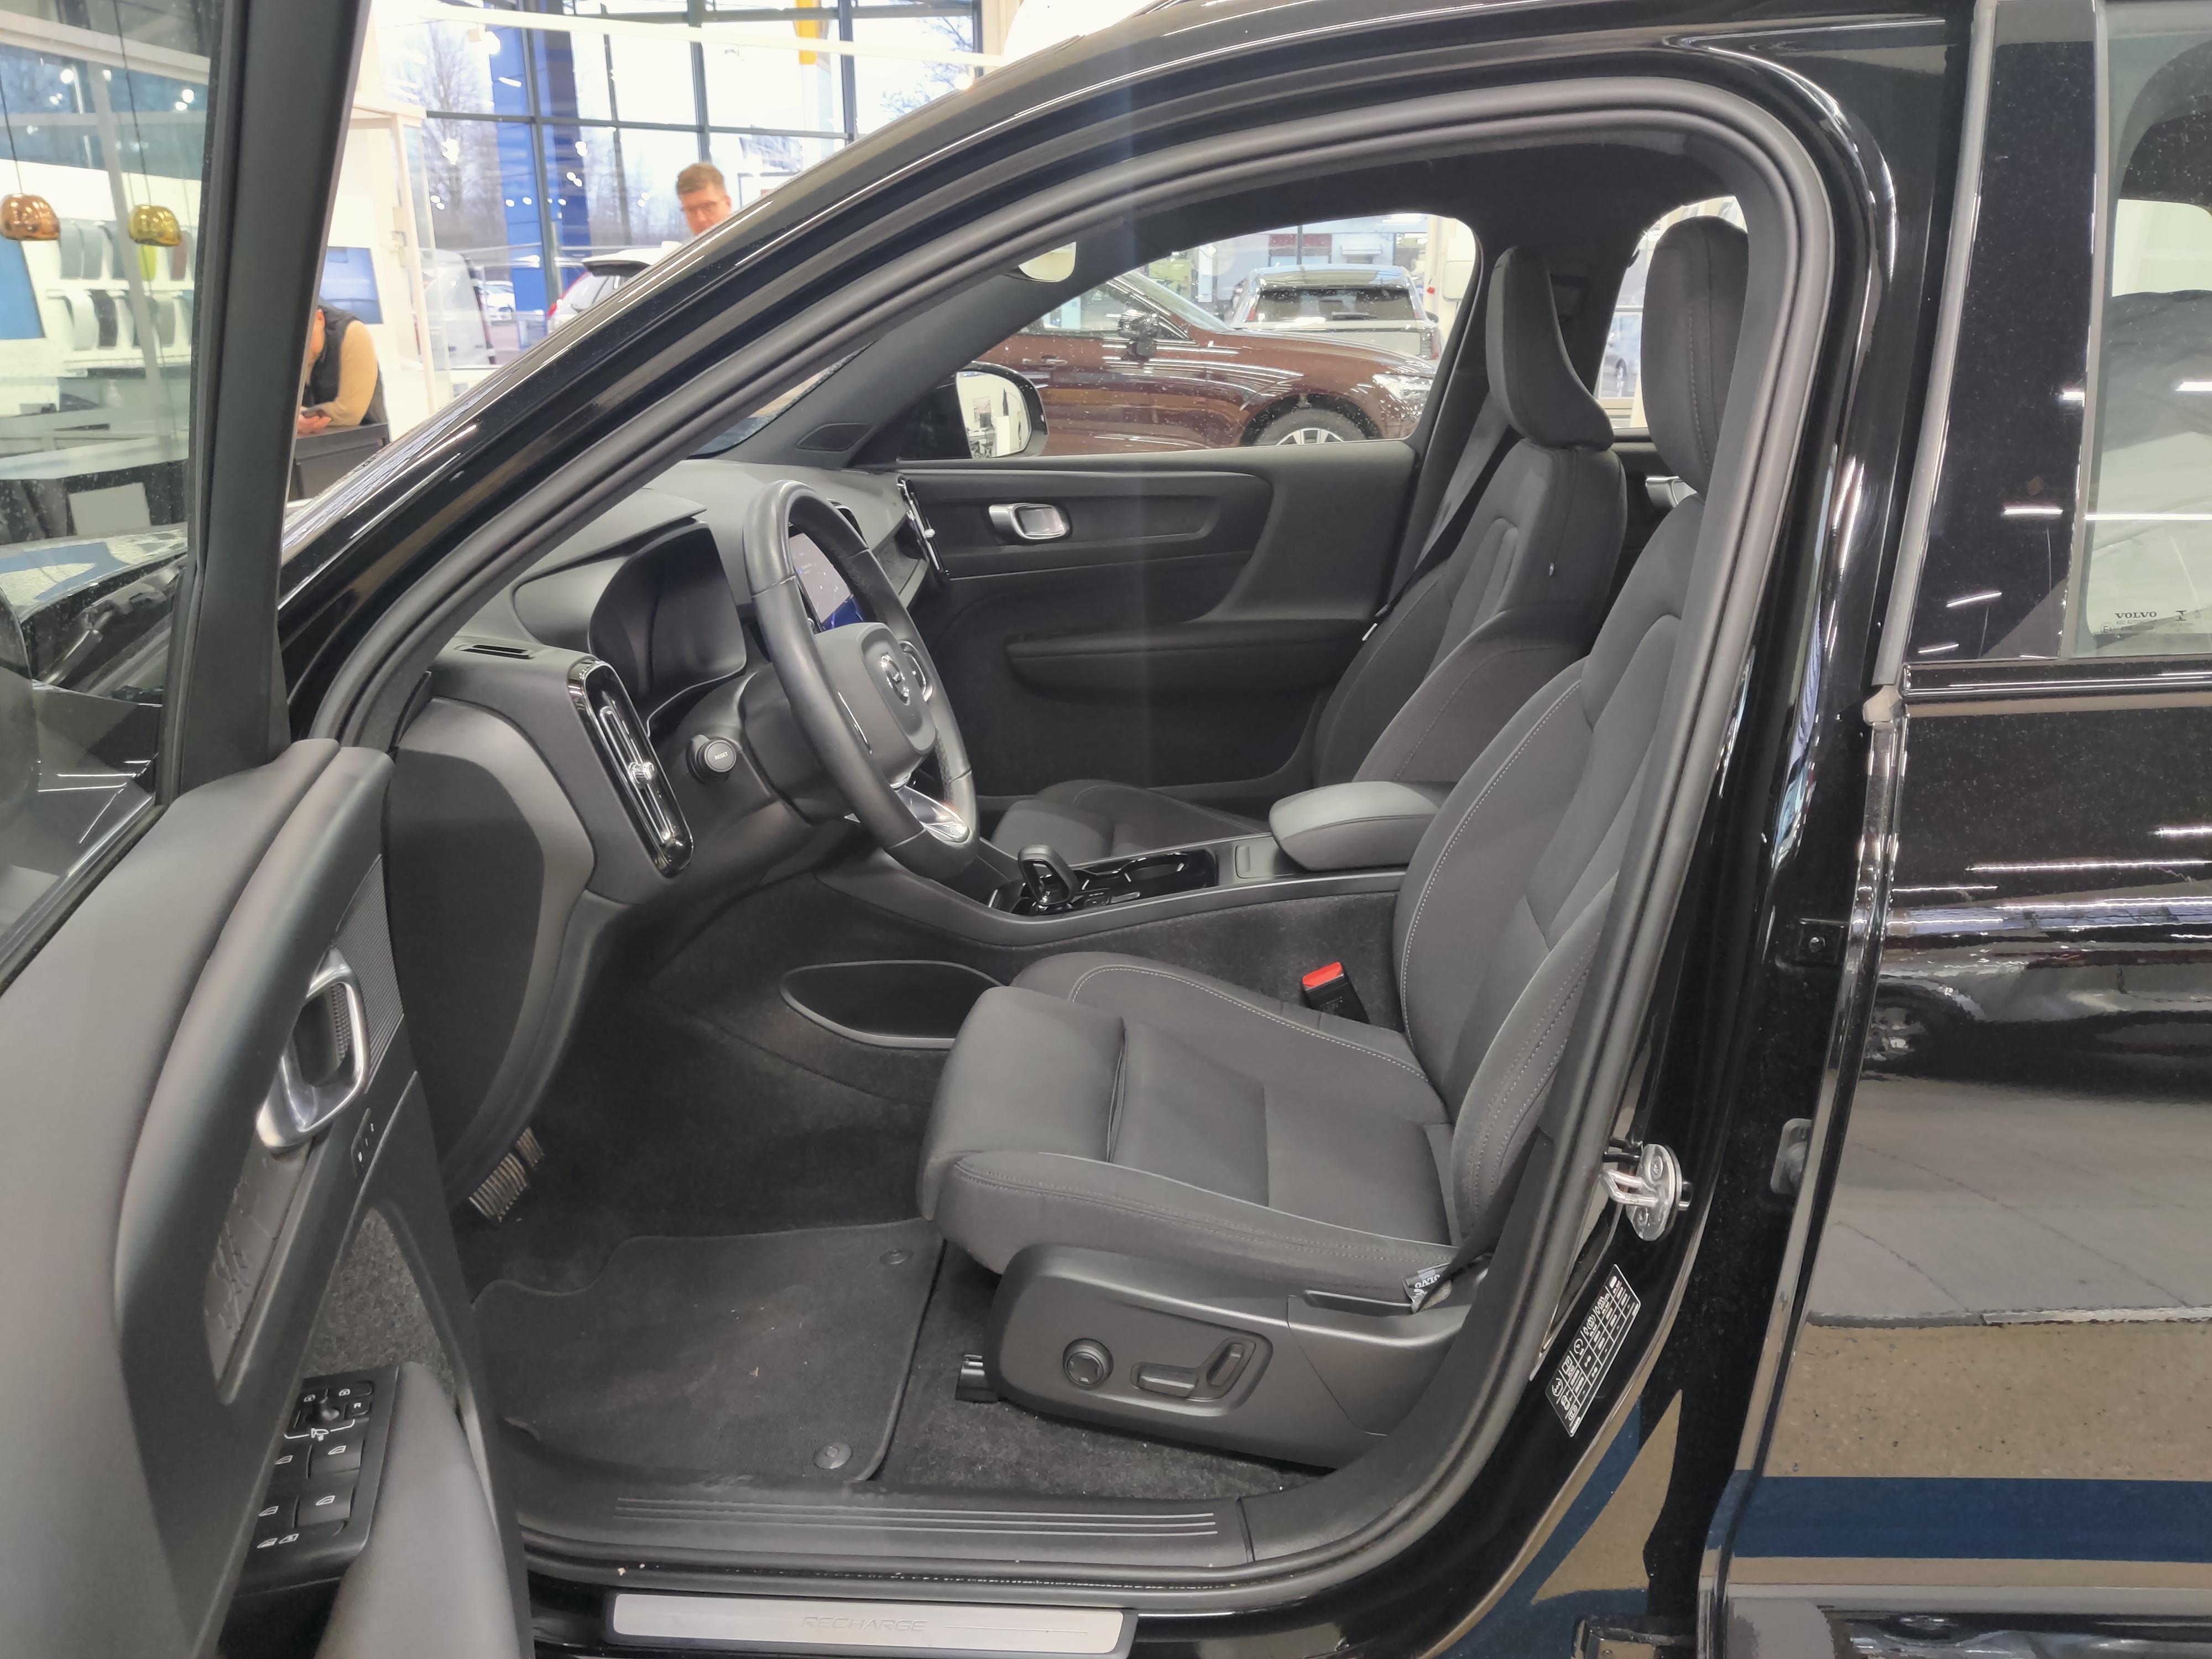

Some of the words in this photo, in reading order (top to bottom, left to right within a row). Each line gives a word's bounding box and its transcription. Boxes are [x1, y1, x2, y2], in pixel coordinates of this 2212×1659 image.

[714, 751, 728, 760] RESET
[1415, 1274, 1441, 1288] OLVO
[801, 1616, 927, 1631] RECHARGE
